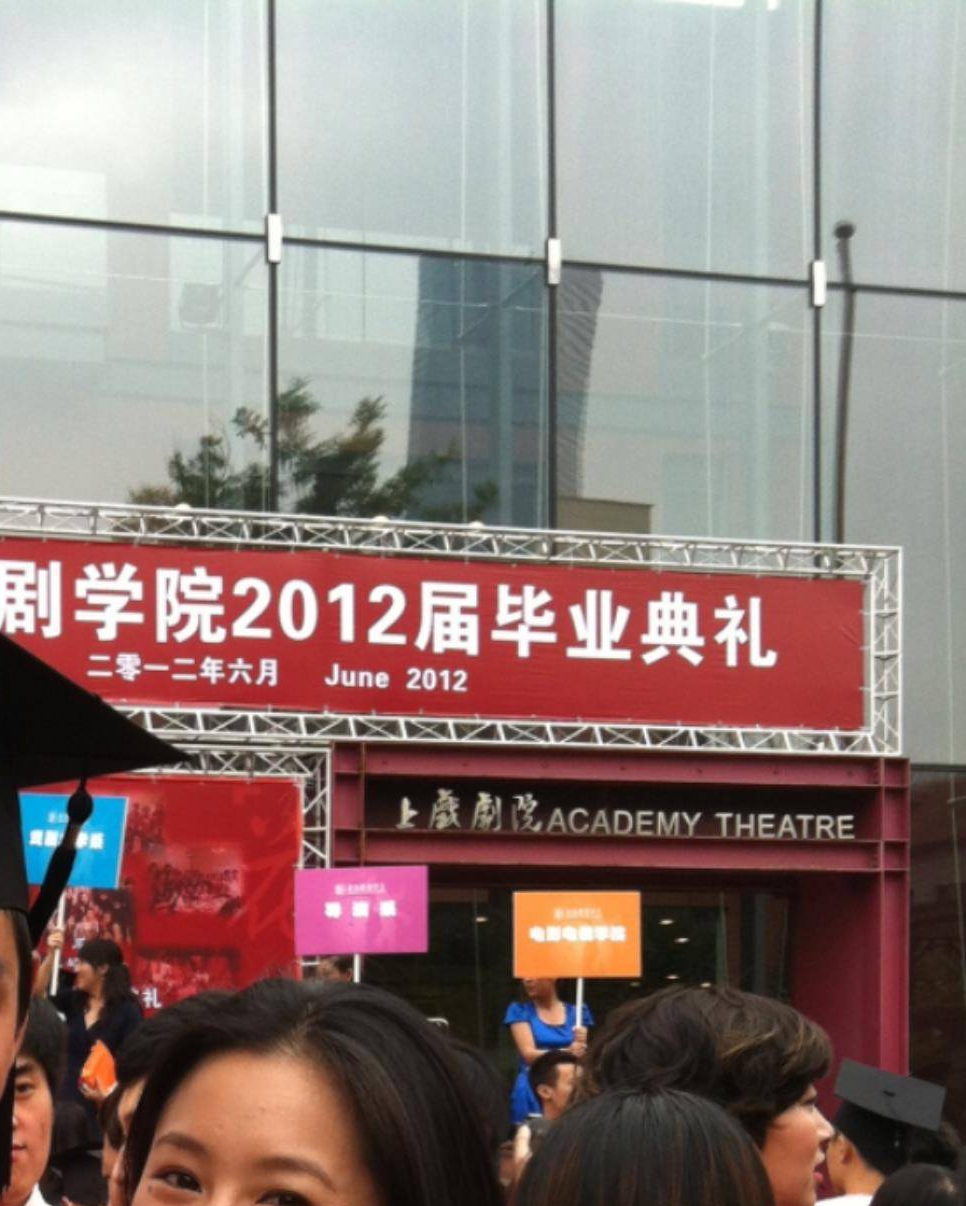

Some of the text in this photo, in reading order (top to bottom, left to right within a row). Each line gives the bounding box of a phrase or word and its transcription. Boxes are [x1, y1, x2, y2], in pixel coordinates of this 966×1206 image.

[87, 653, 468, 693] 二零一二年六月 June 2012
[546, 807, 702, 837] ACADEMY
[715, 812, 855, 840] THEATRE
